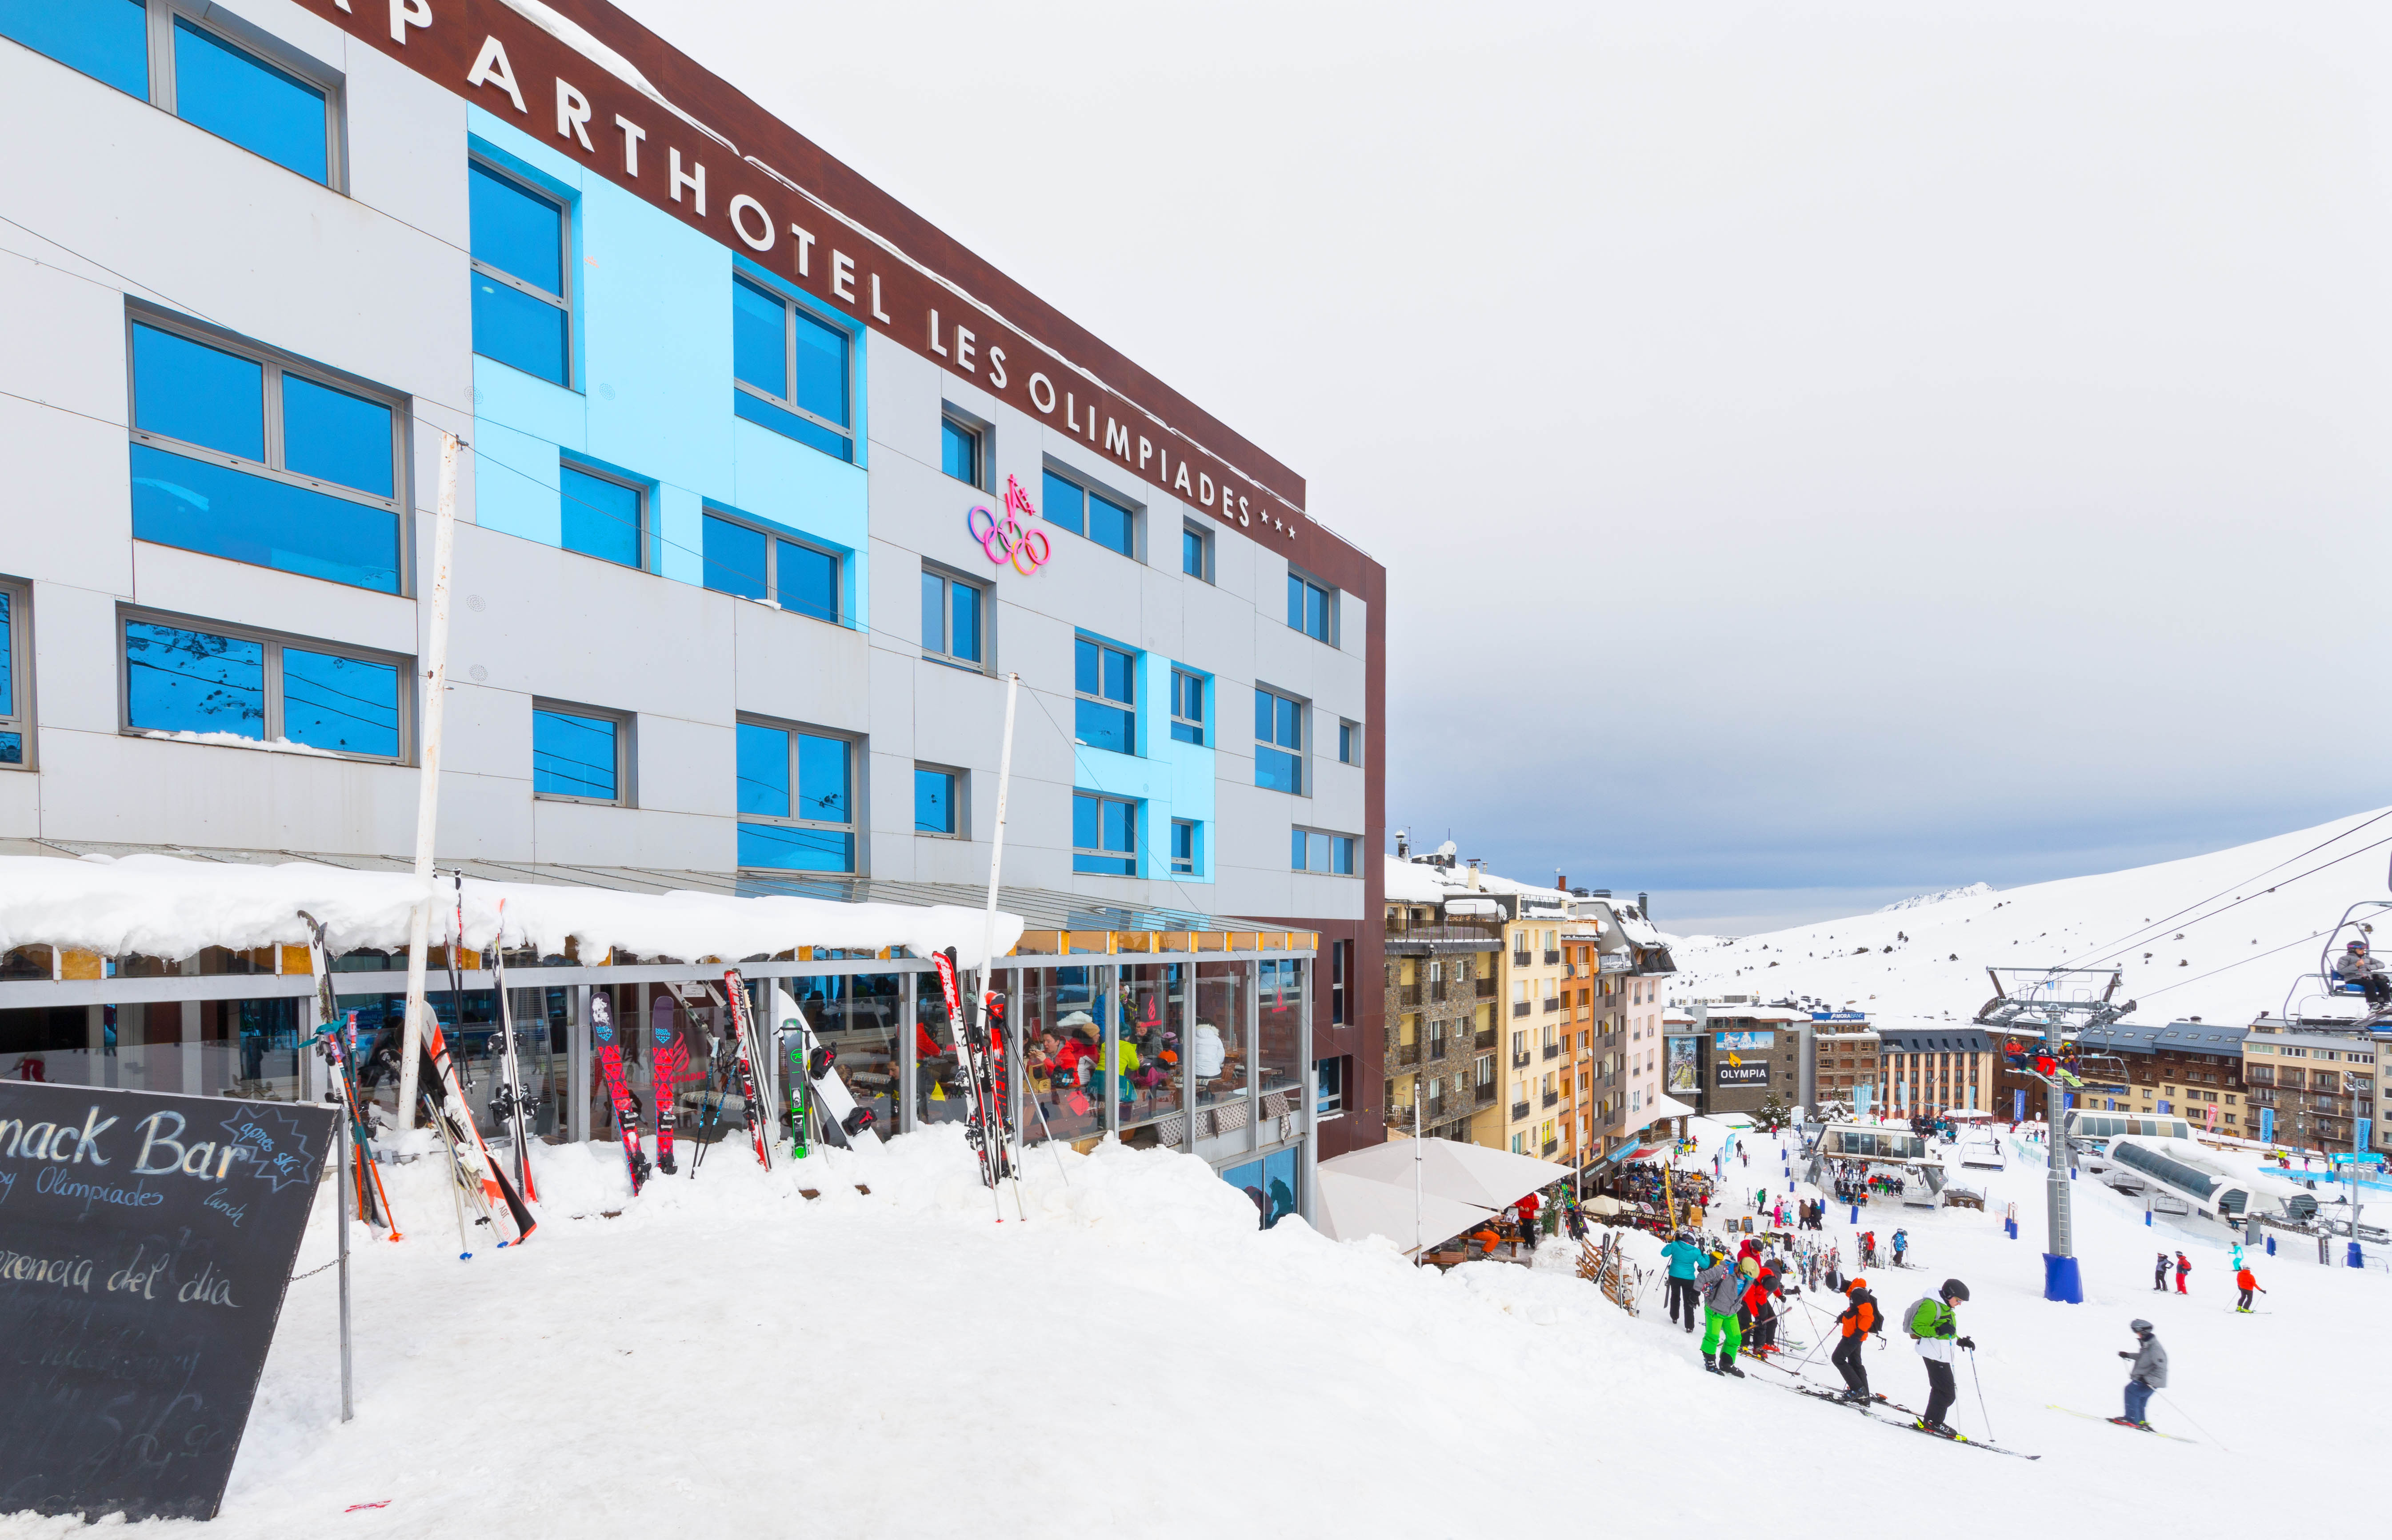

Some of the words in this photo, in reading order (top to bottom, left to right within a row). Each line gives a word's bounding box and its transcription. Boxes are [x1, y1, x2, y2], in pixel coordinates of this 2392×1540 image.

[333, 0, 890, 325] PARTHOTEL
[929, 308, 1008, 389] LES
[1028, 372, 1250, 528] OLIMPIADES
[736, 980, 746, 1018] ATOMIC
[1720, 1068, 1766, 1079] OLYMPIA
[131, 1110, 247, 1183] Bar
[36, 1166, 164, 1212] Olimpiades
[204, 1188, 248, 1228] lunch
[499, 1205, 510, 1219] JOY
[107, 1244, 171, 1300] del
